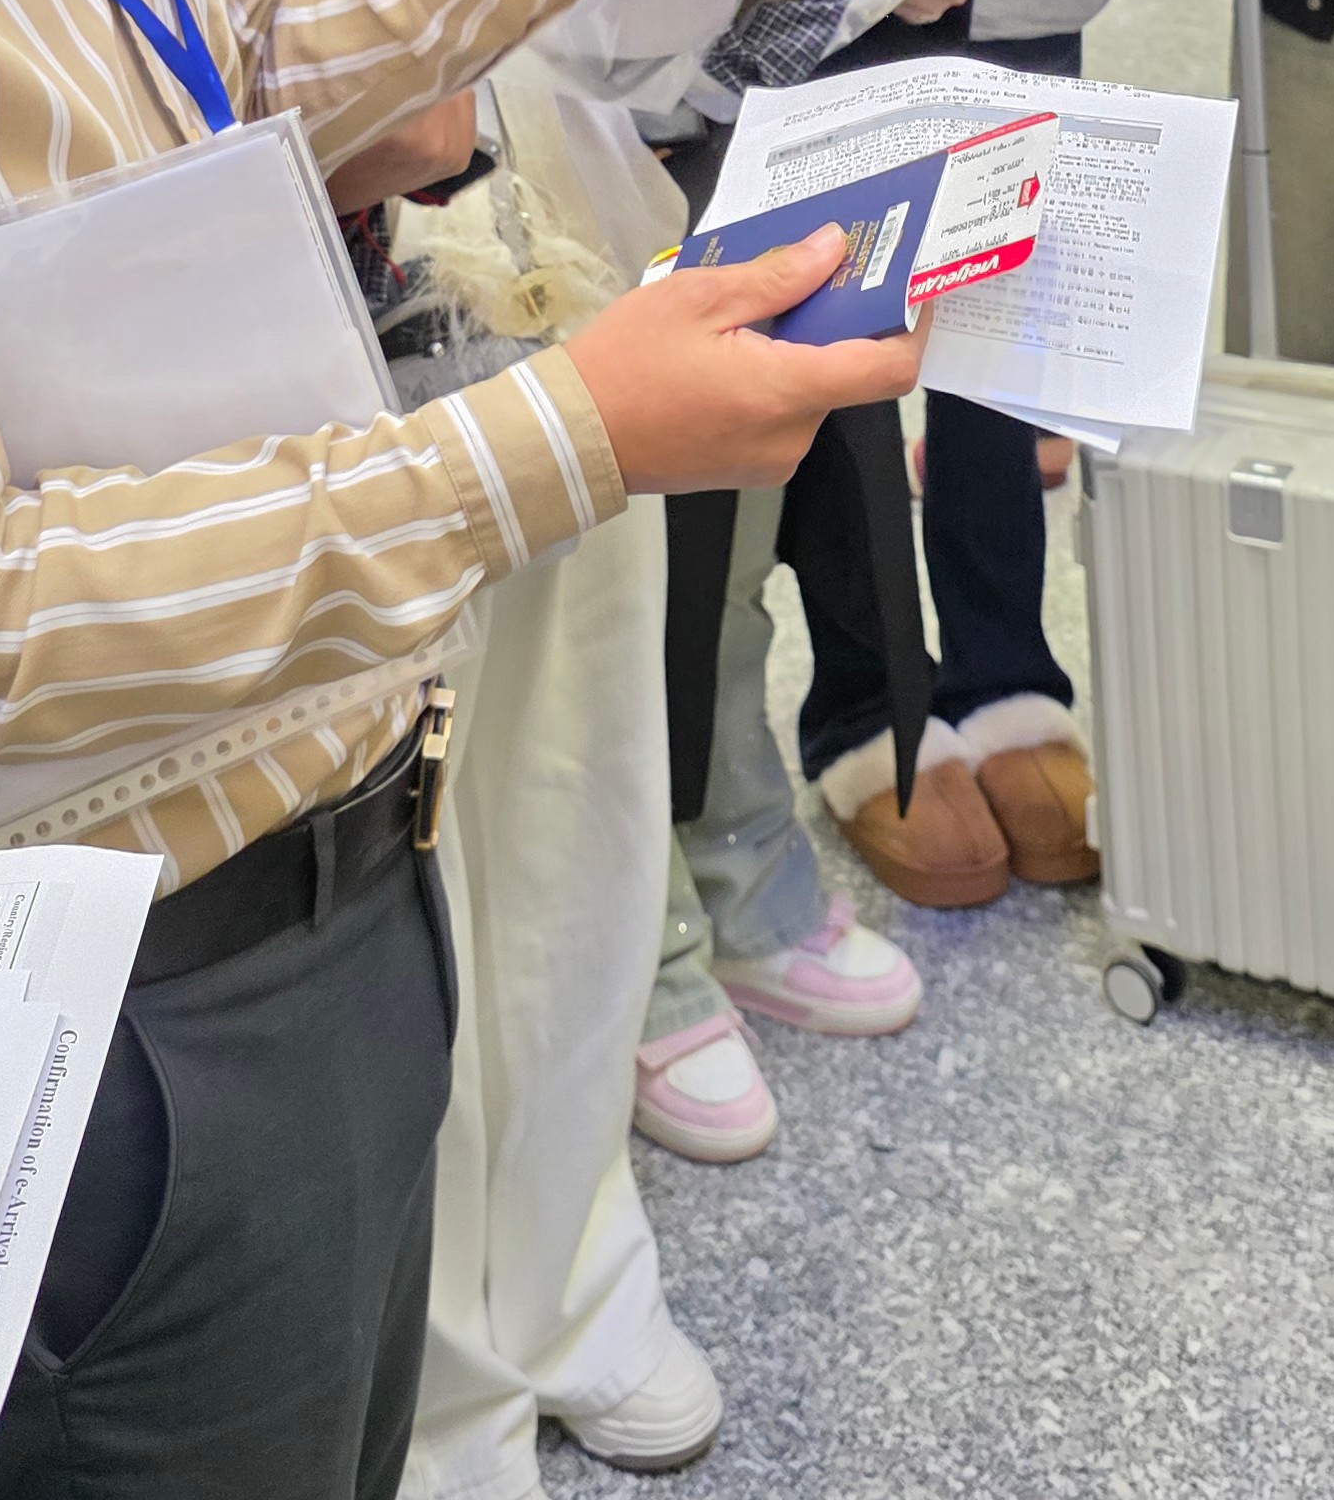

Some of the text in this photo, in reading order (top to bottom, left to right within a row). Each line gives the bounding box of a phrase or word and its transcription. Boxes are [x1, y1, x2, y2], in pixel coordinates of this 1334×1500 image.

[953, 86, 988, 96] Republic
[1003, 91, 1027, 100] Korea
[27, 1029, 78, 1150] Confirmation
[19, 1154, 38, 1176] of
